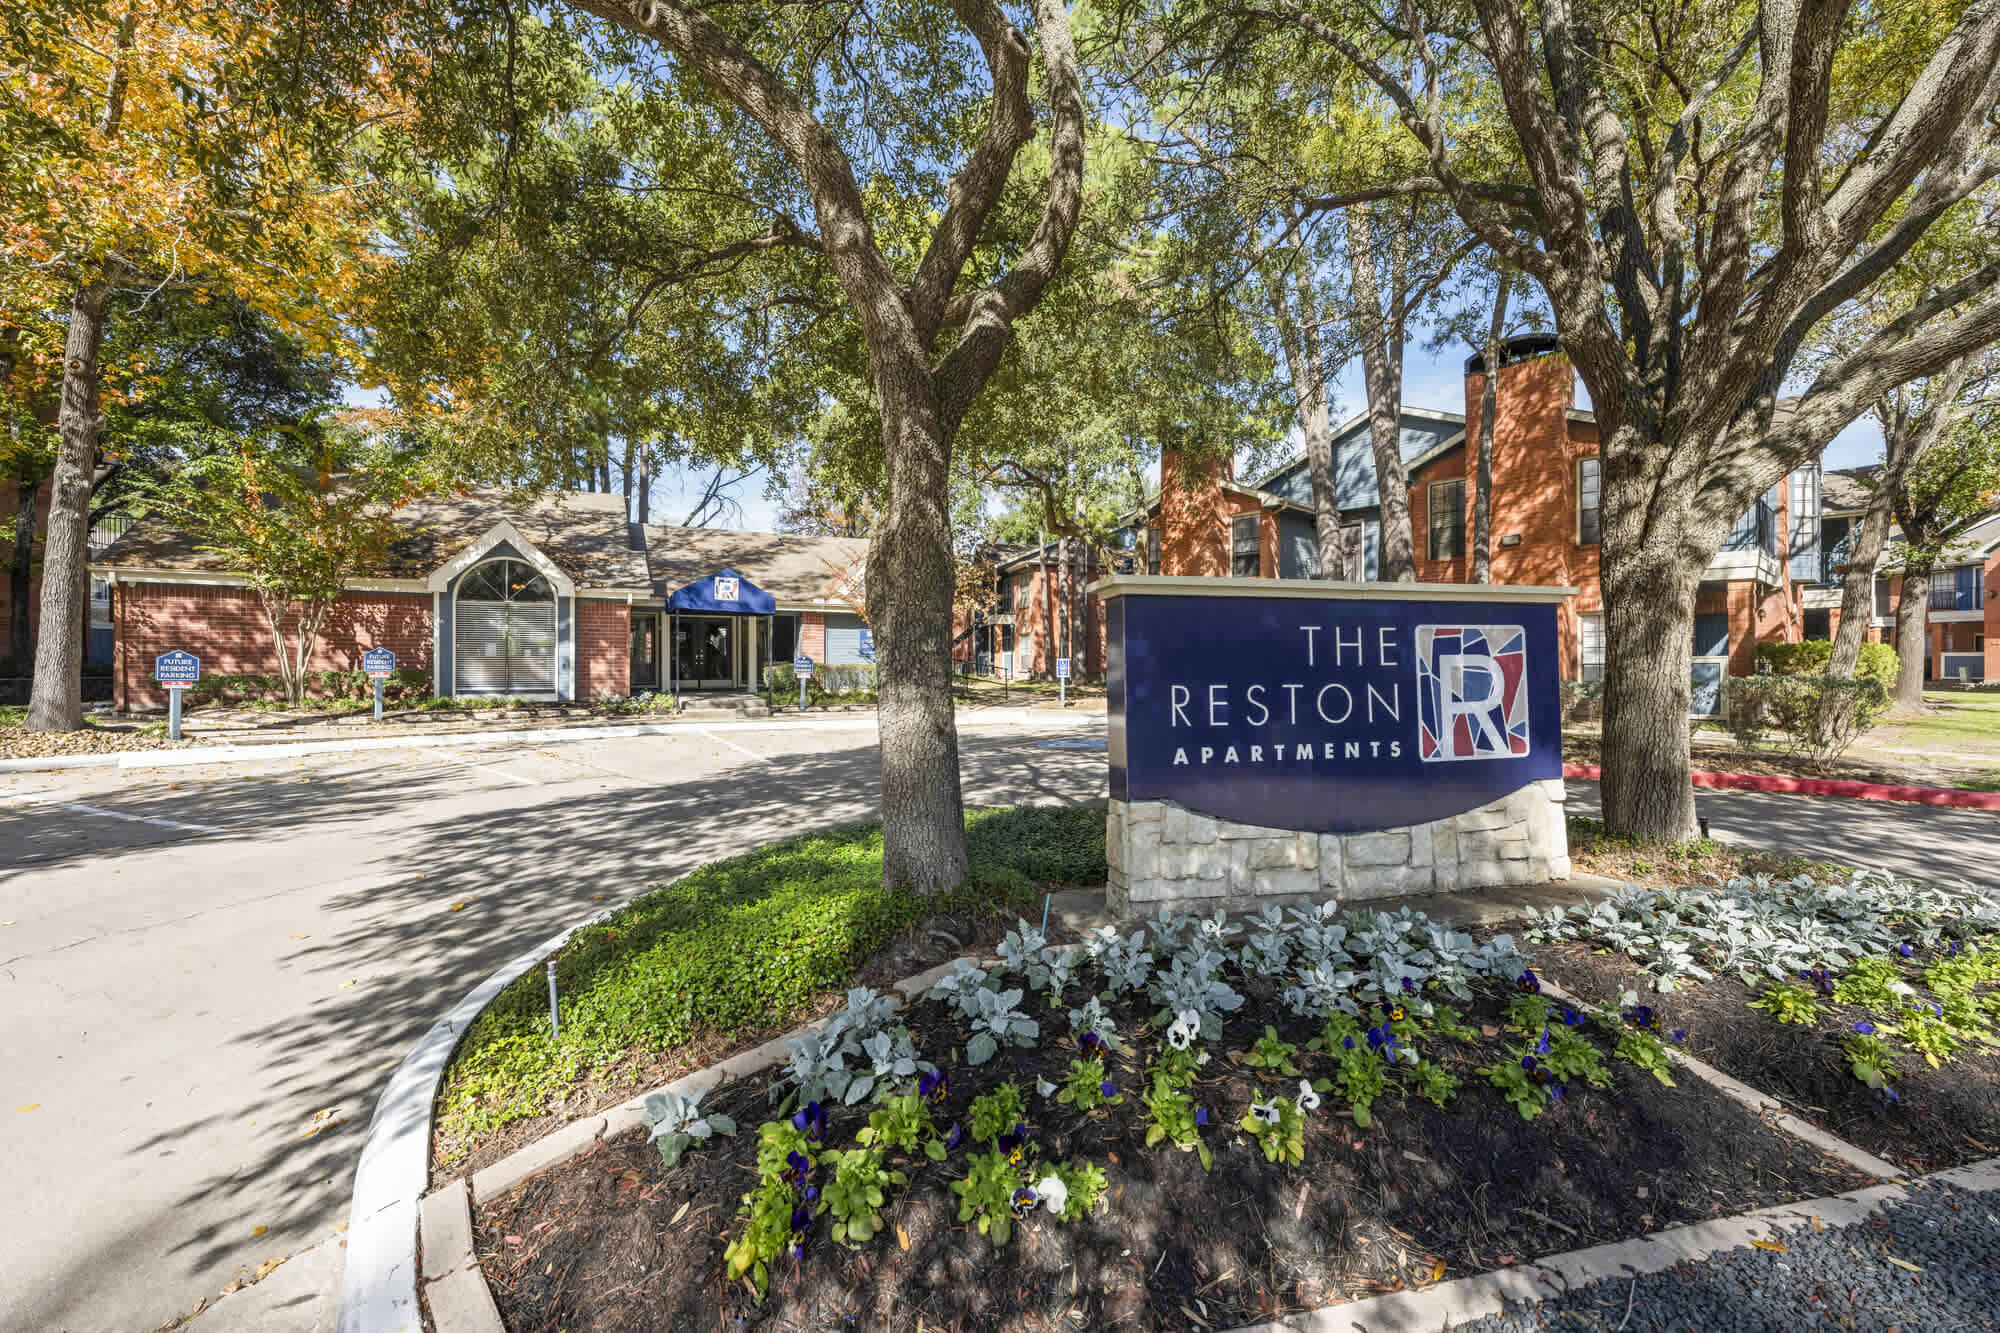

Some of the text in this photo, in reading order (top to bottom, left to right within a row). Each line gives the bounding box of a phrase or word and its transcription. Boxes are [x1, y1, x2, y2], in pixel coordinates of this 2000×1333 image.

[1299, 625, 1398, 666] THE
[1171, 682, 1400, 727] RESTON
[1439, 654, 1510, 759] R
[1173, 741, 1401, 765] APARTMENTS
